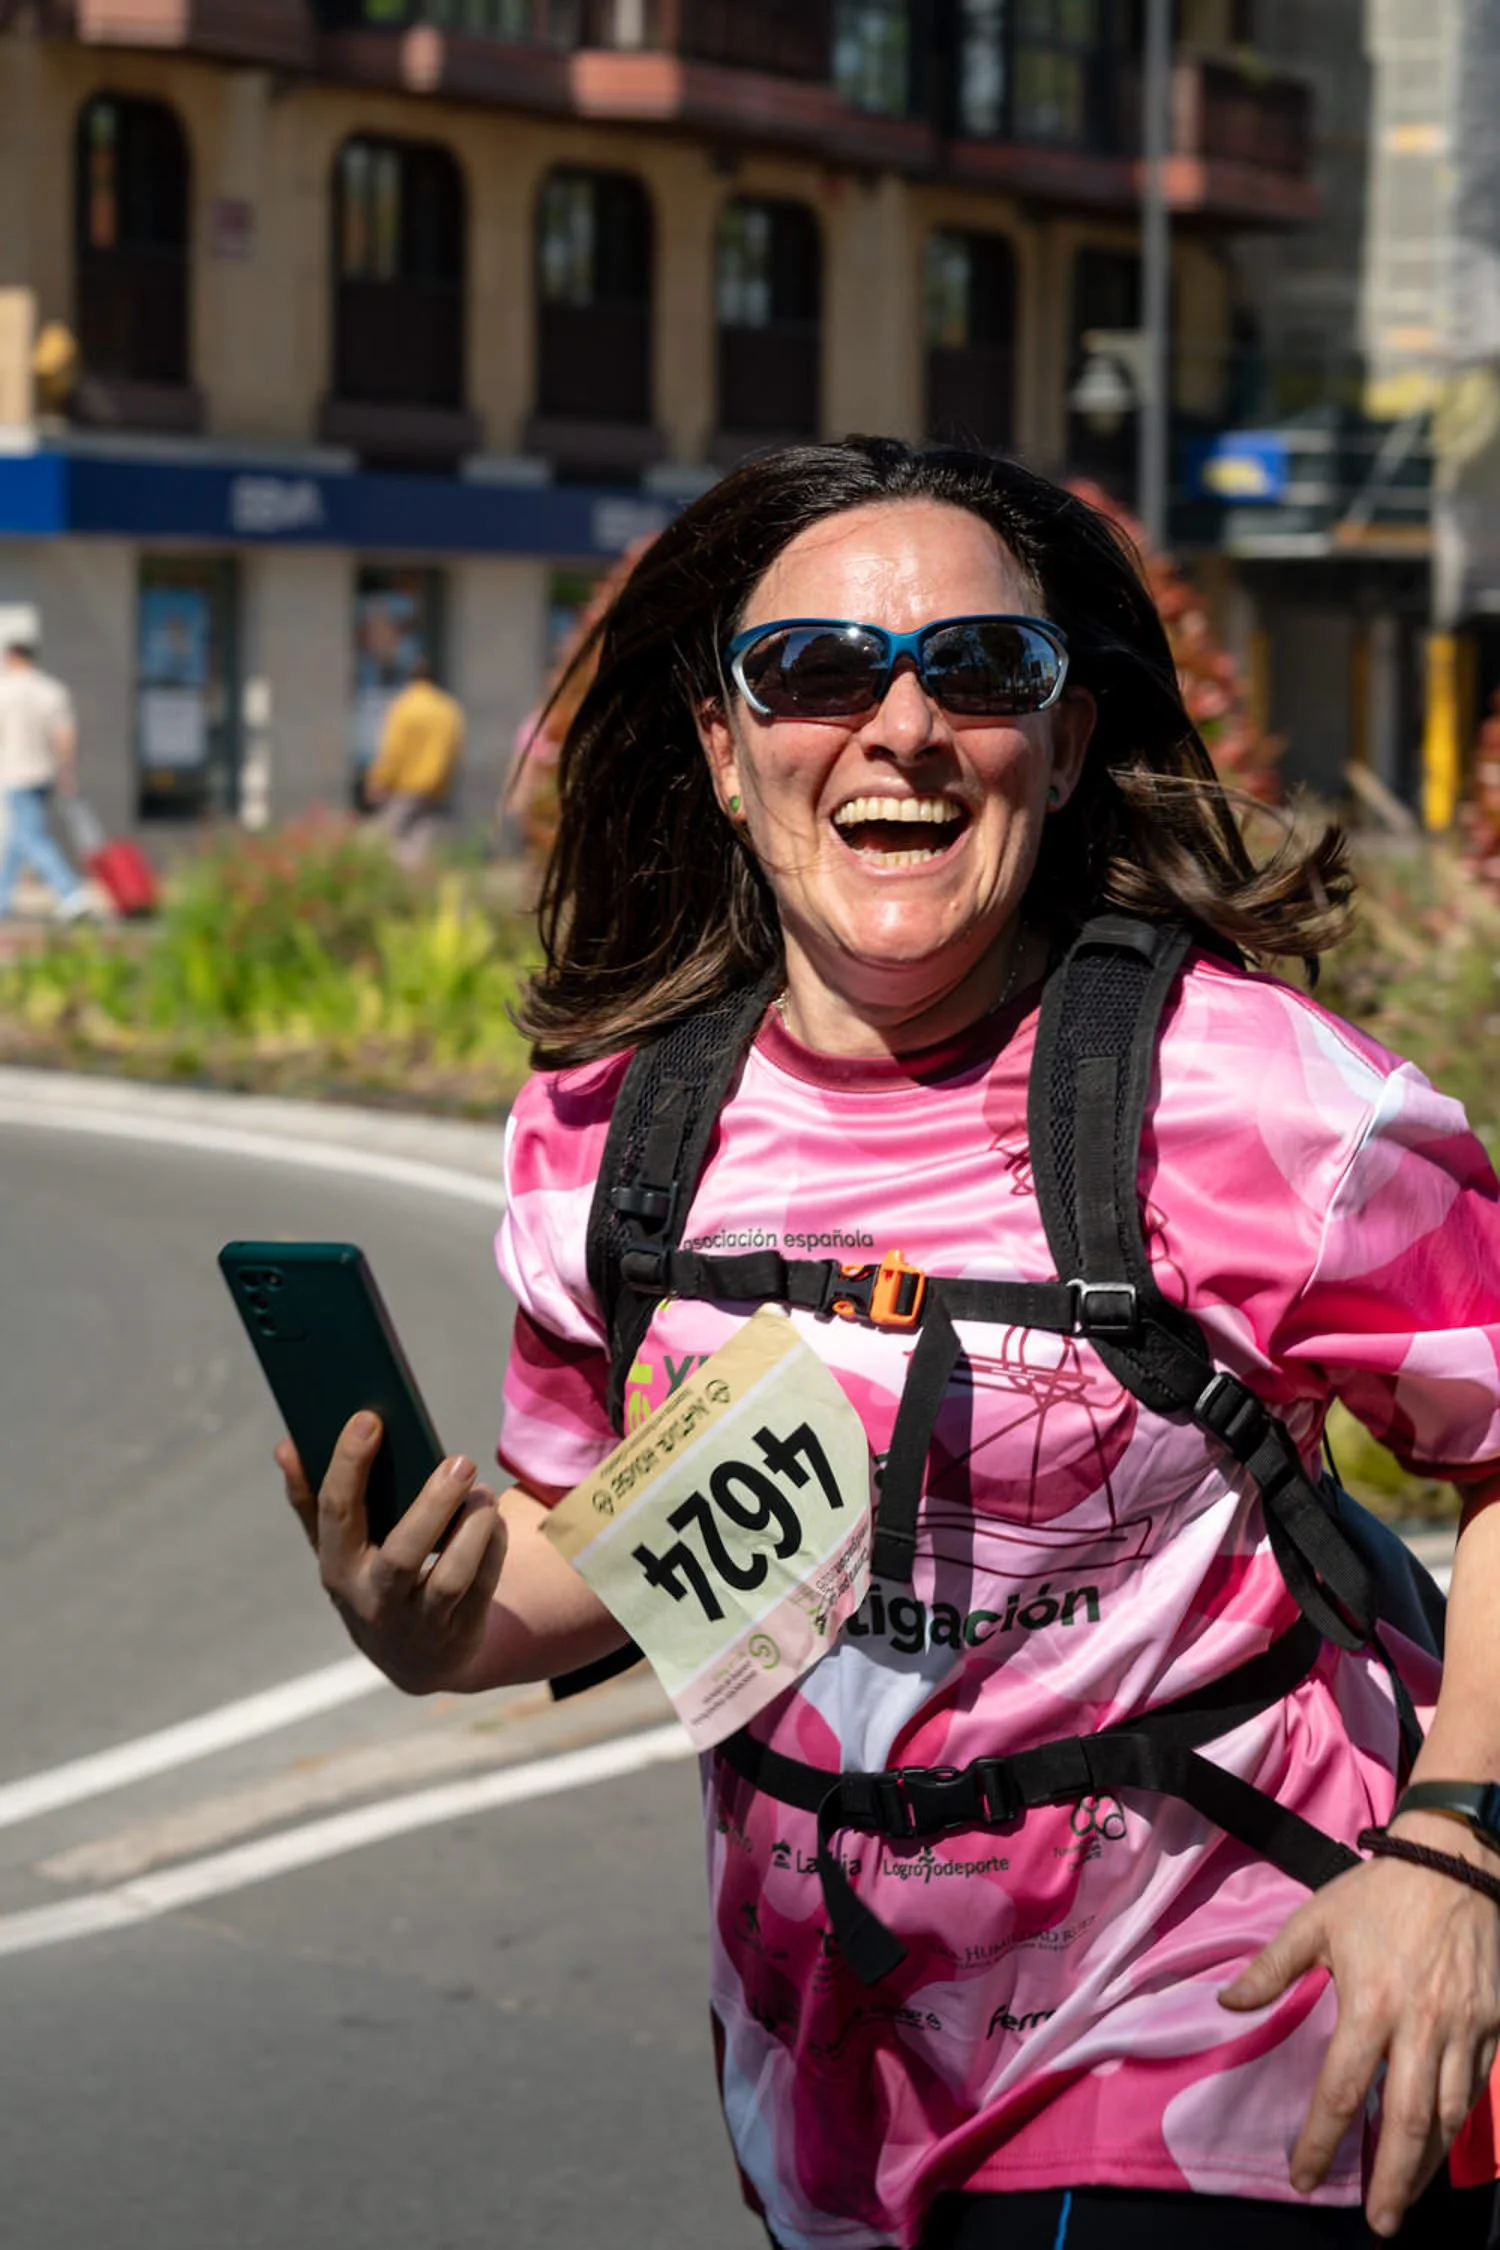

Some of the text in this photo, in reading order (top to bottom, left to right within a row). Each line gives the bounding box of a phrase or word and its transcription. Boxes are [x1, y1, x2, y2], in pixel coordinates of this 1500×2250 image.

[683, 1229, 874, 1252] asociación española
[632, 1421, 844, 1622] 4624
[845, 1583, 1100, 1654] tigación
